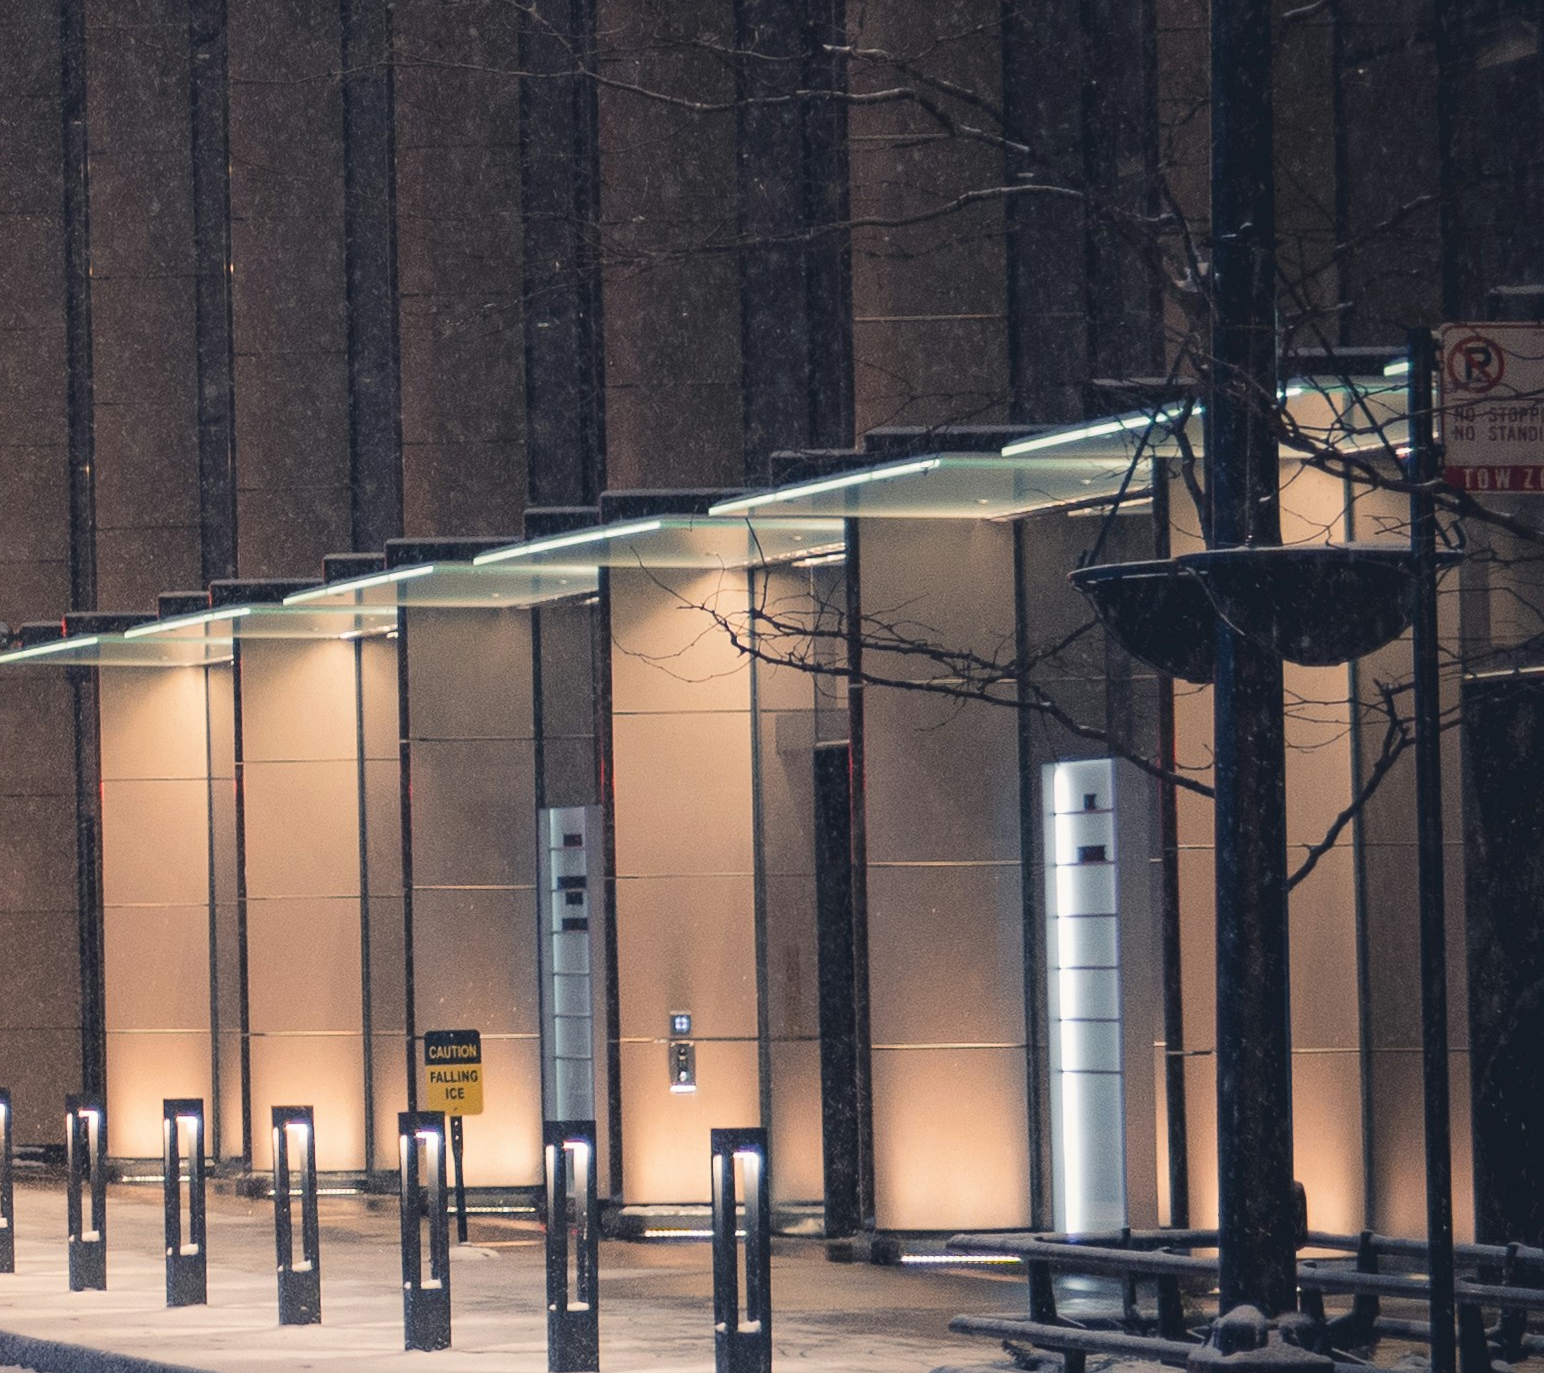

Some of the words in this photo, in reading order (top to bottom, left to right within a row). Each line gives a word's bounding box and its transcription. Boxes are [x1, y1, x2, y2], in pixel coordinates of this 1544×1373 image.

[1453, 407, 1475, 424] NO
[1453, 425, 1475, 442] NO
[1464, 469, 1510, 489] TOW
[429, 1044, 477, 1059] CAUTION
[430, 1070, 479, 1084] FALLING
[445, 1087, 466, 1100] ICE
